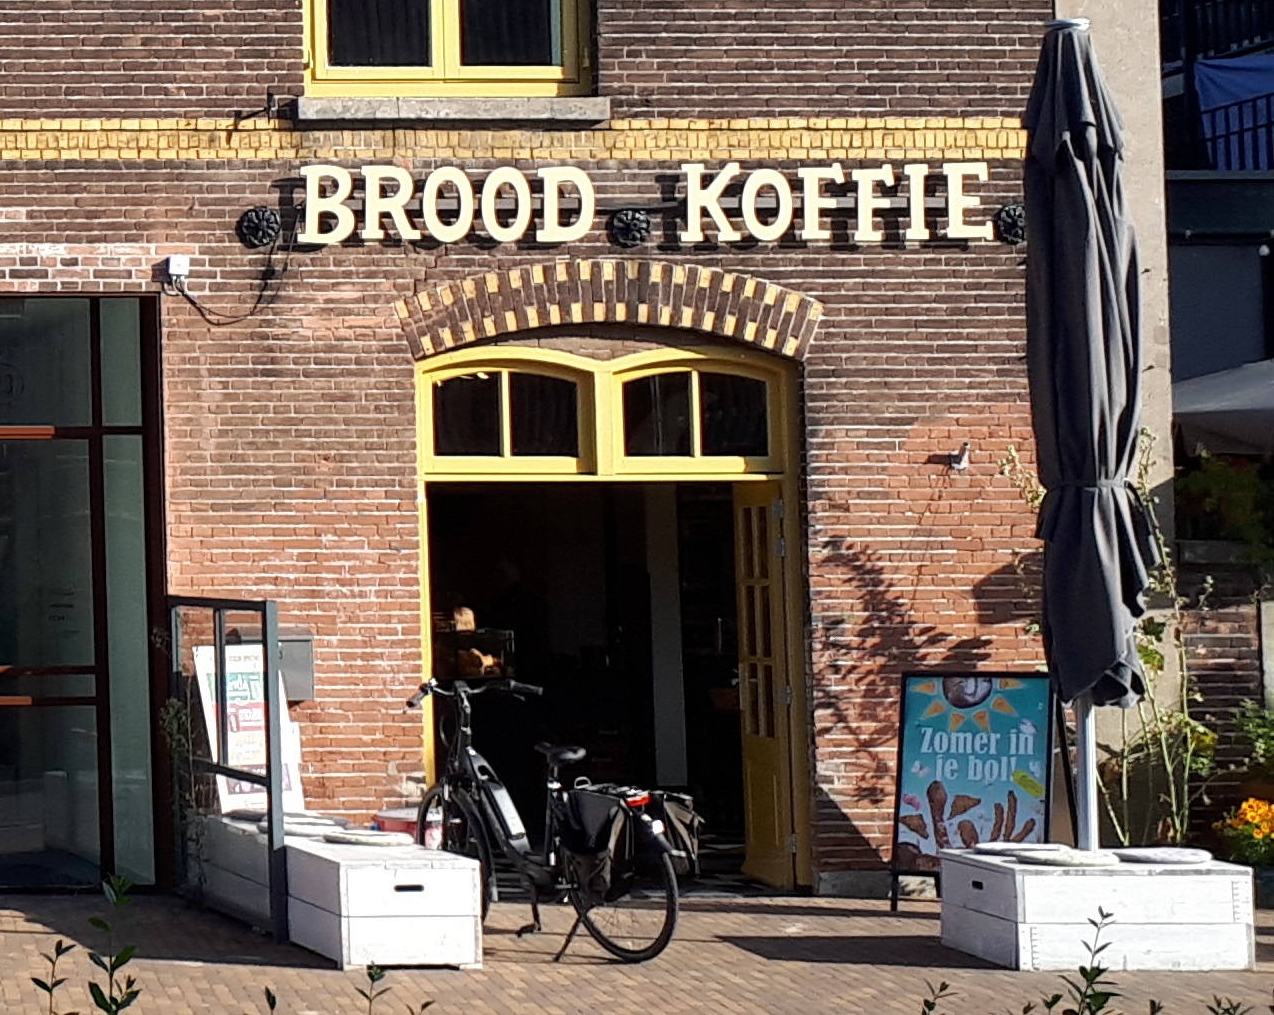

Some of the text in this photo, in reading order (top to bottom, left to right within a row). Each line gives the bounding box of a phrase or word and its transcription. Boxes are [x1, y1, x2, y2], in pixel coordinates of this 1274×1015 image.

[297, 161, 994, 245] BROOD KOFFIE
[920, 727, 1034, 756] Zomer in
[935, 754, 959, 782] je
